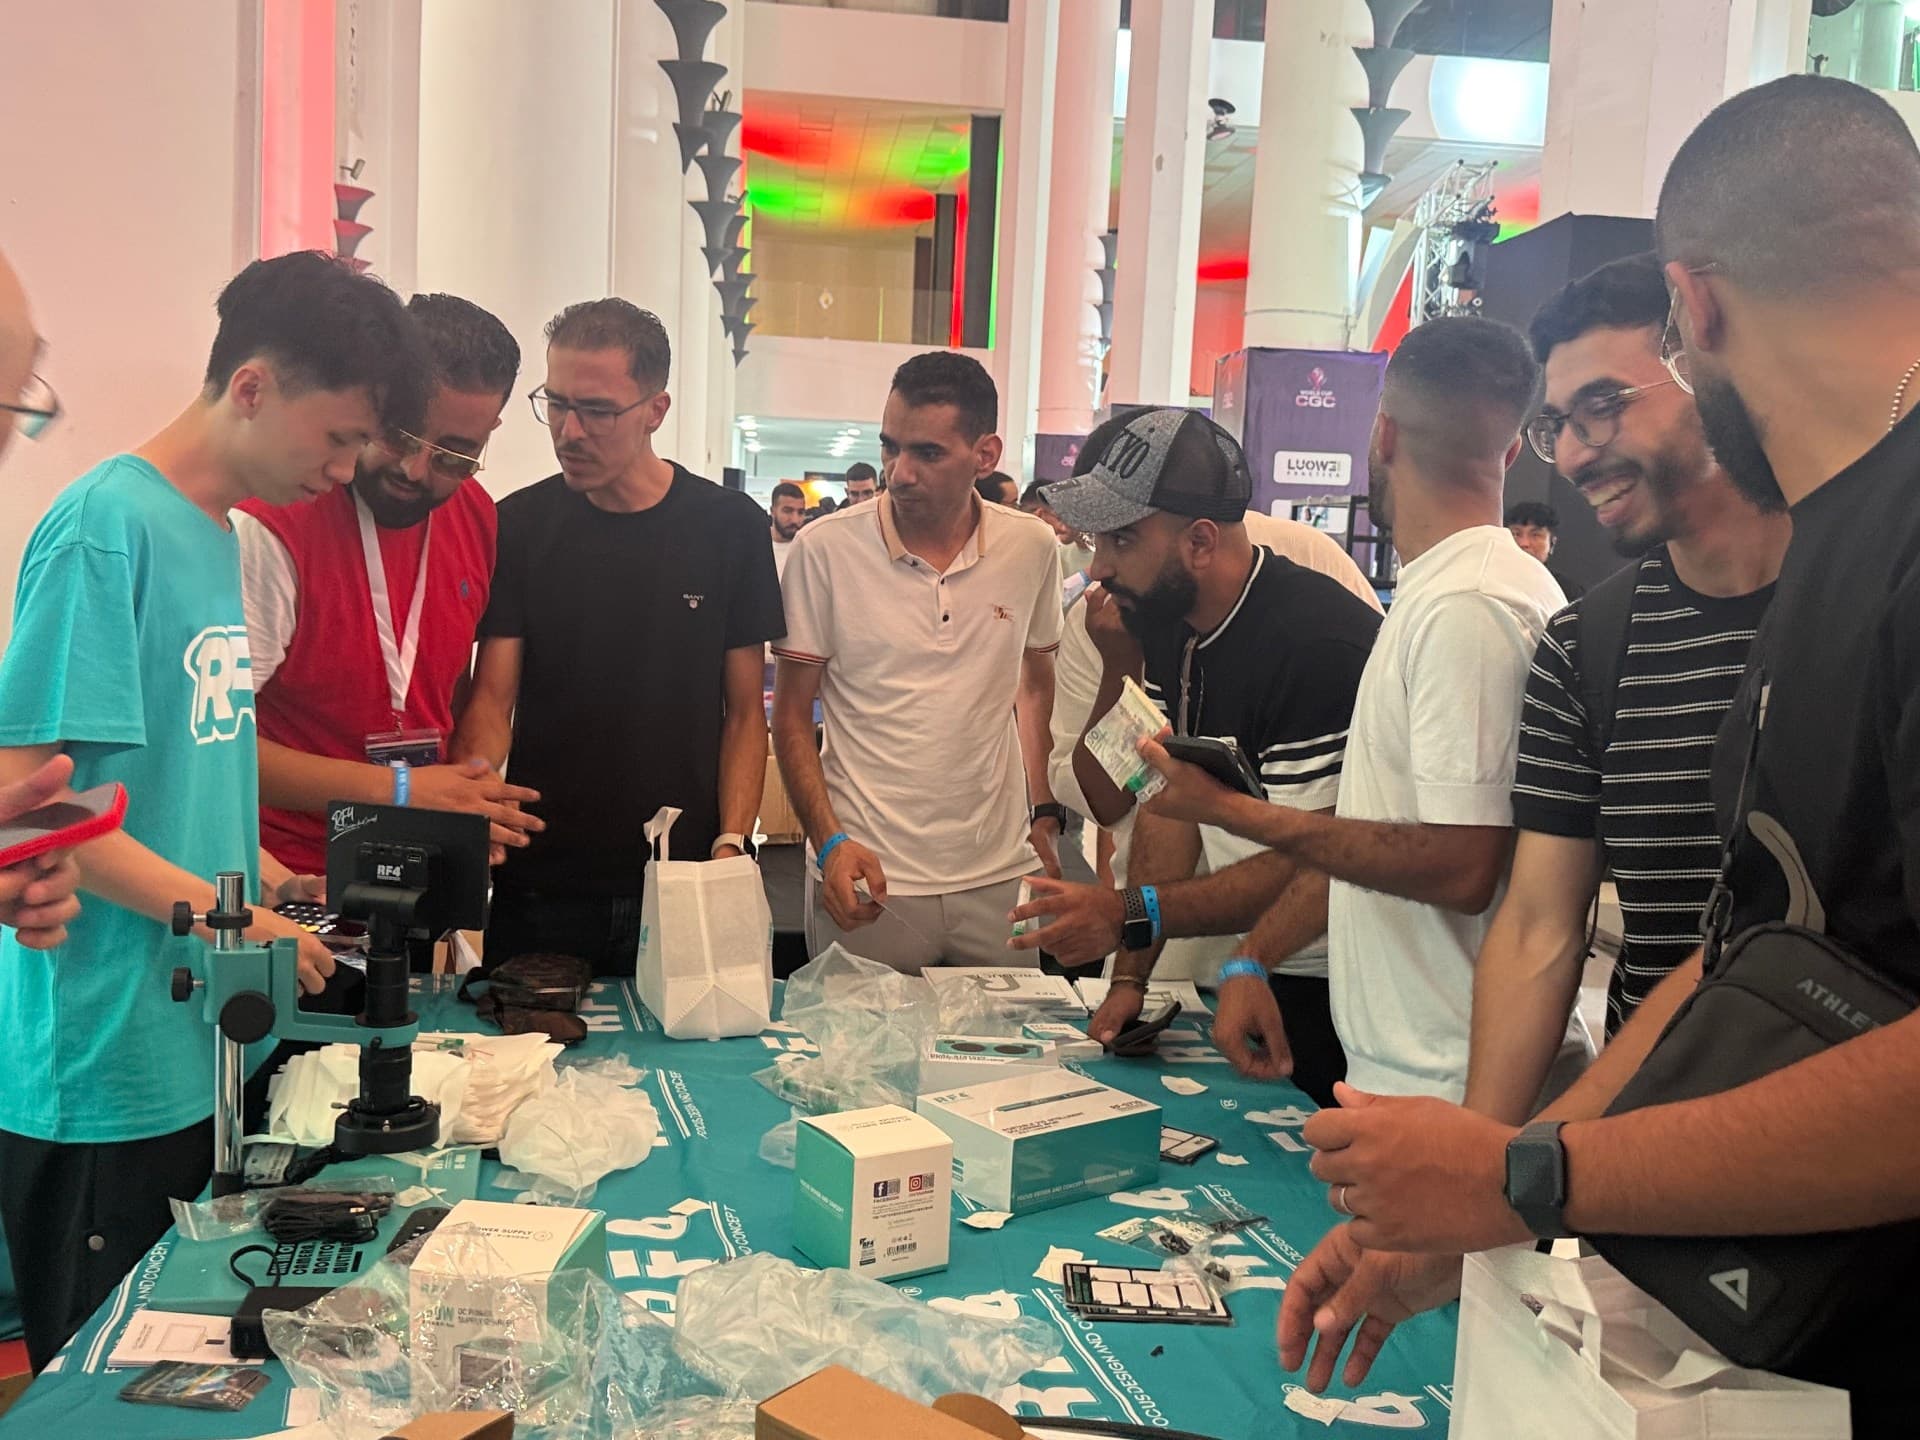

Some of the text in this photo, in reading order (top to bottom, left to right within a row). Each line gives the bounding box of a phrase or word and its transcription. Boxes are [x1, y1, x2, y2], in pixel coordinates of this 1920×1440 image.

[1295, 395, 1336, 408] CGC
[376, 864, 402, 877] RF4
[1796, 978, 1880, 1029] ATHLE
[723, 1204, 751, 1246] CONCEPT
